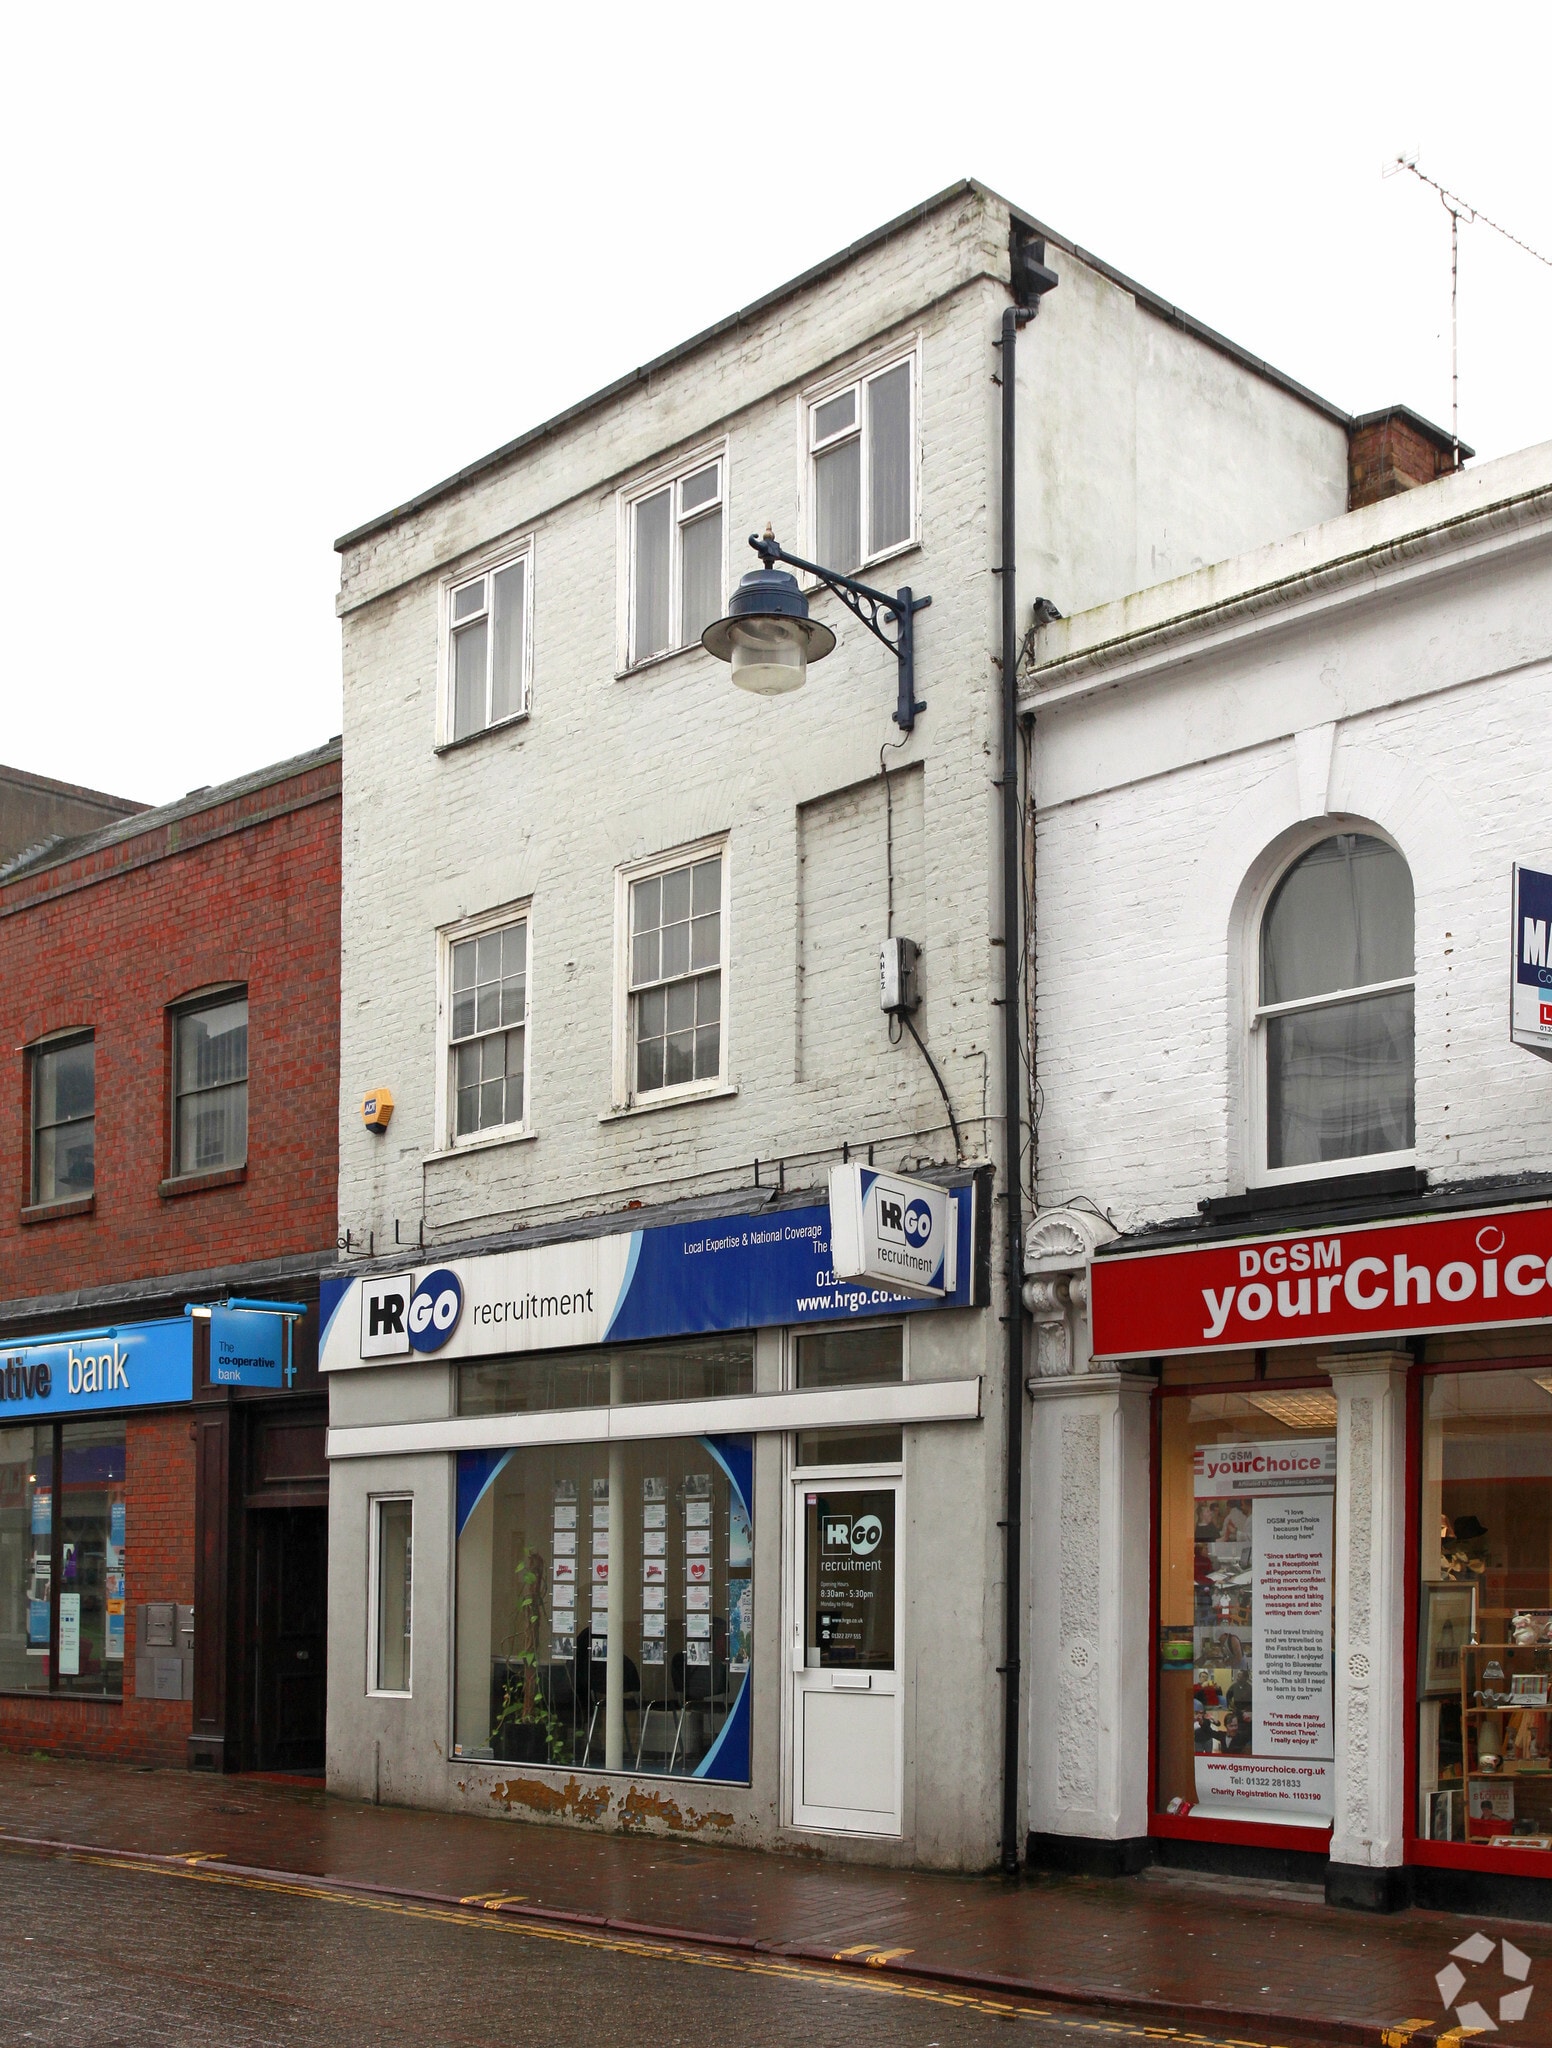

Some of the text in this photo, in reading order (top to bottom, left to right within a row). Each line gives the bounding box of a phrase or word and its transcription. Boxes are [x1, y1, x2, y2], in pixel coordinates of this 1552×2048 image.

[684, 1225, 822, 1254] Local Expertise & National Coverage
[813, 1240, 828, 1253] The
[877, 1247, 932, 1273] recruitment
[1239, 1239, 1341, 1278] DGSM
[1201, 1226, 1552, 1338] yourChoic
[473, 1288, 594, 1325] recruitment
[219, 1341, 234, 1353] The
[68, 1343, 130, 1394] bank
[218, 1356, 275, 1368] co-operative
[218, 1368, 241, 1380] bank
[1220, 1452, 1252, 1460] DGSM
[1207, 1450, 1321, 1478] yourChoice
[821, 1558, 882, 1571] recruitment
[850, 1590, 874, 1600] 5:30pm
[1207, 1764, 1325, 1776] www.dgsmyourchoice.org.uk
[1230, 1776, 1301, 1787] Tel: 01322 281833
[1211, 1788, 1234, 1796] Charity
[1236, 1789, 1277, 1798] Registration
[1292, 1792, 1321, 1800] 1103190
